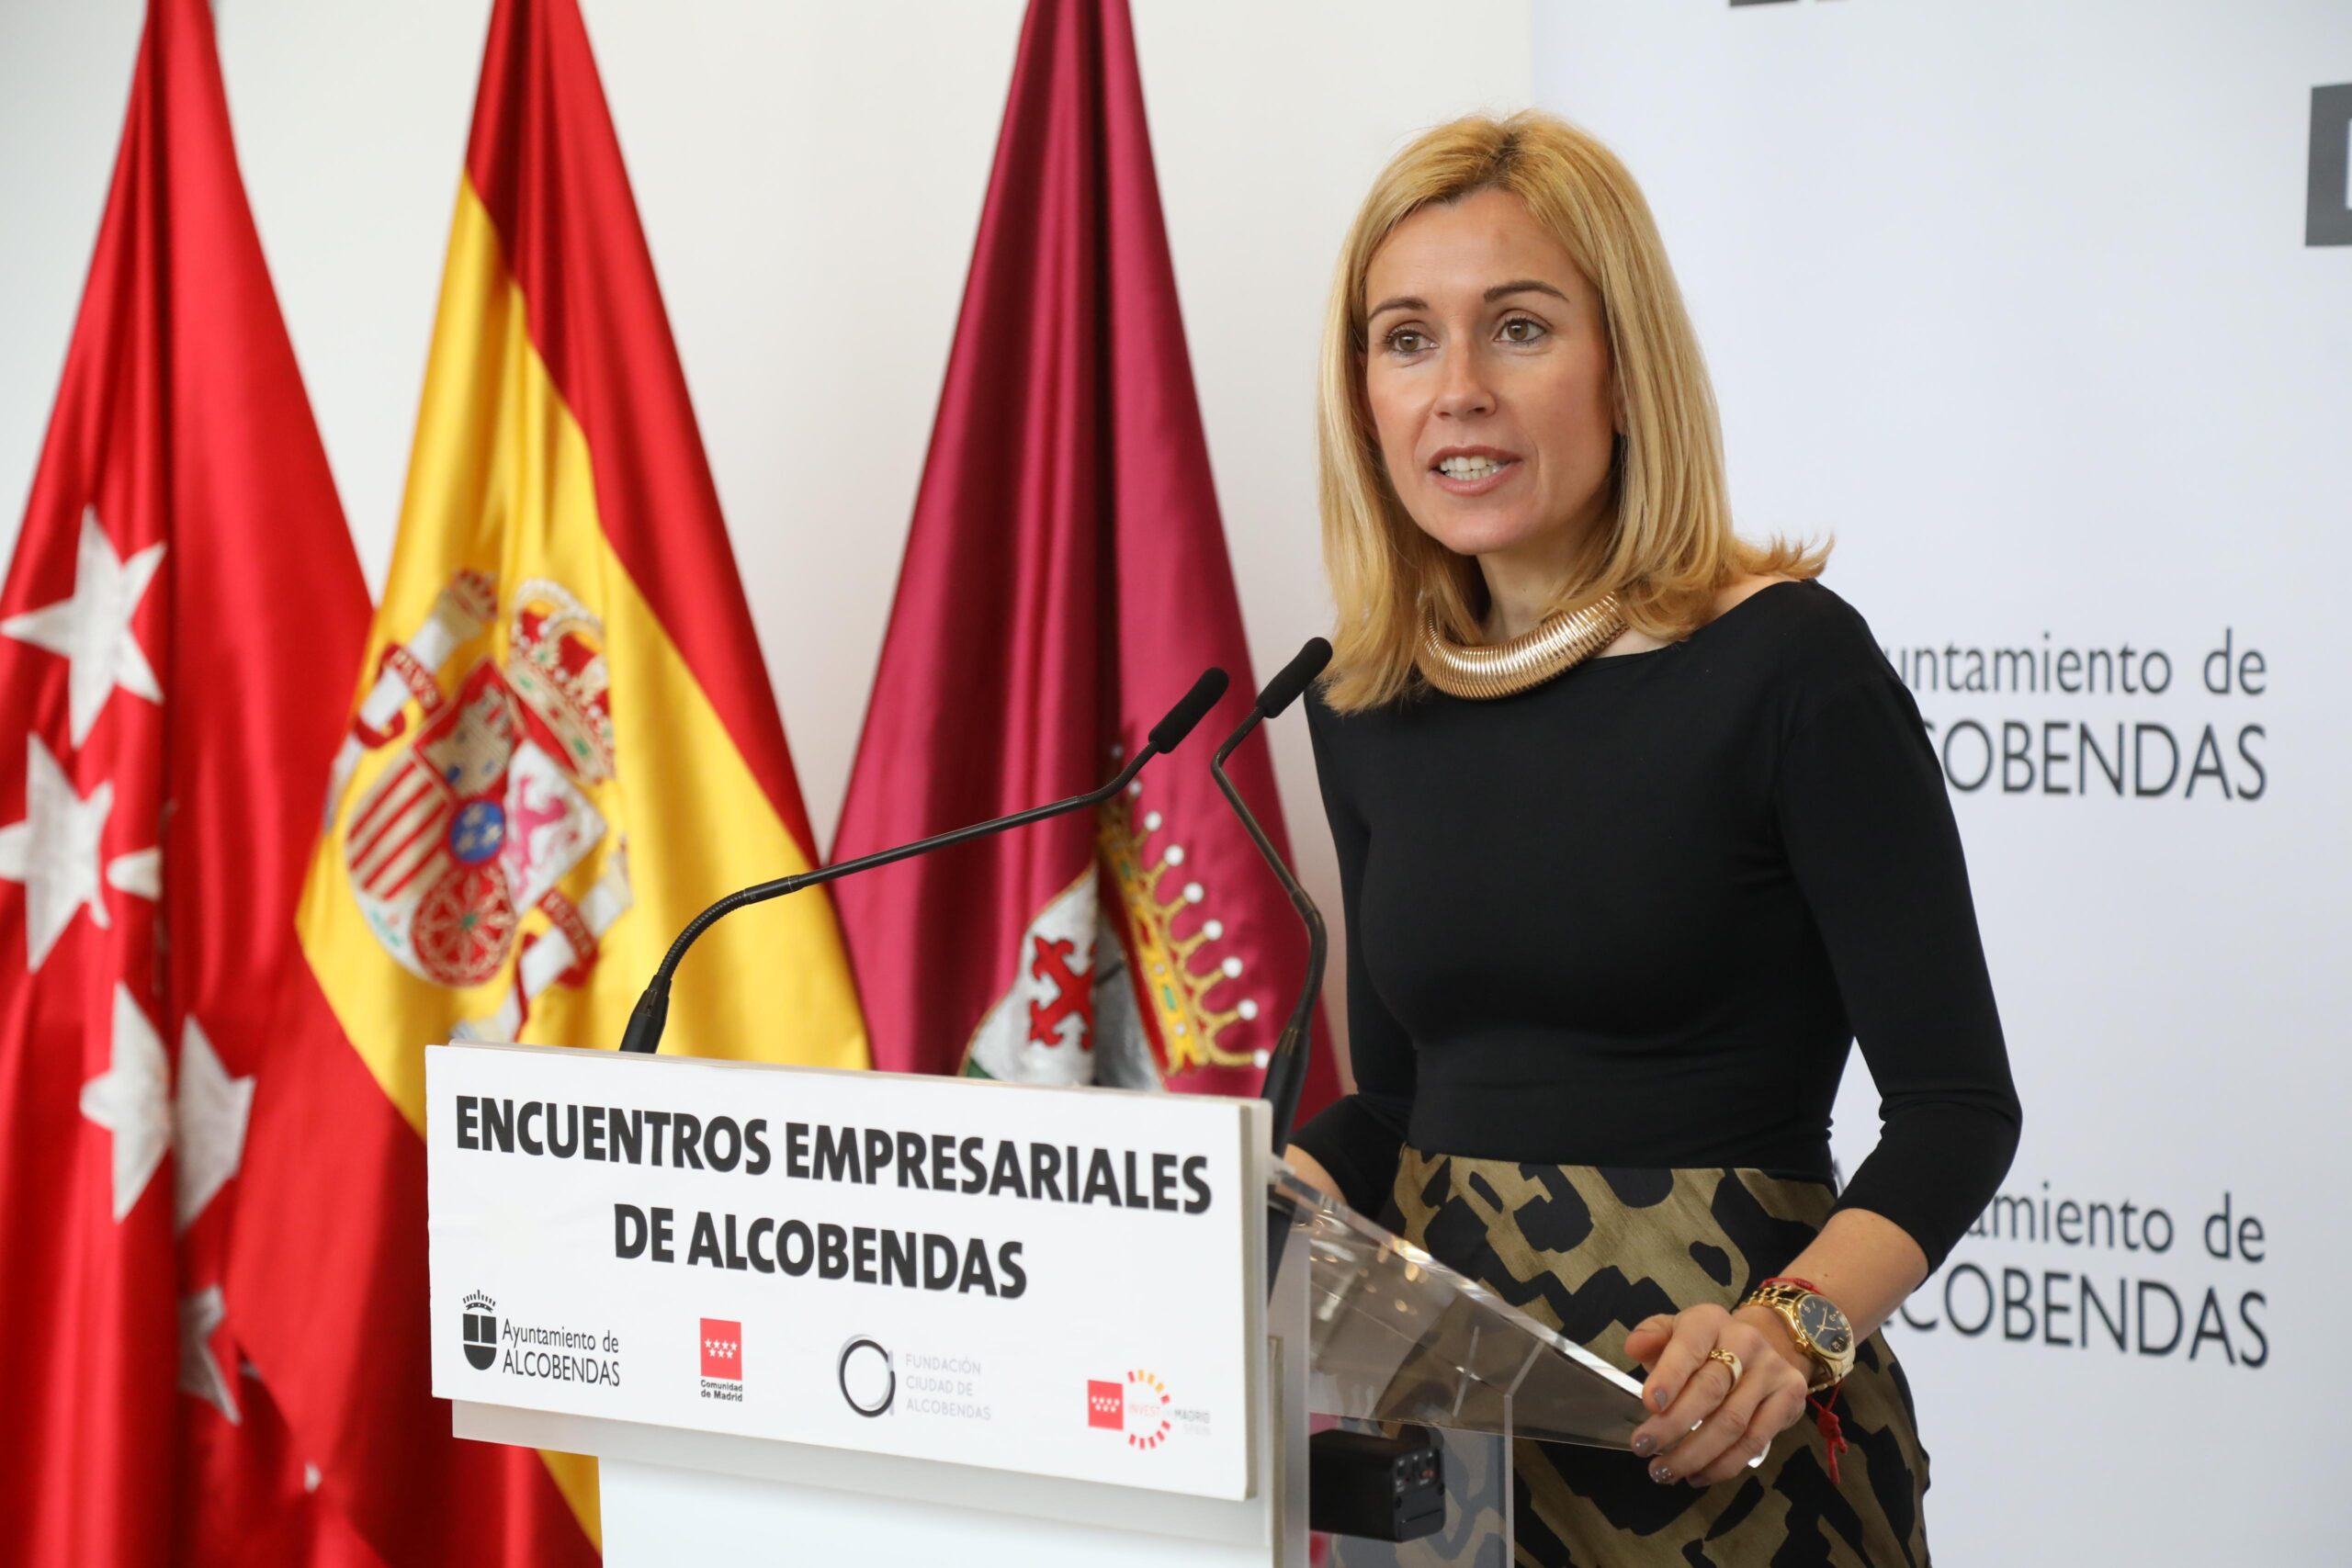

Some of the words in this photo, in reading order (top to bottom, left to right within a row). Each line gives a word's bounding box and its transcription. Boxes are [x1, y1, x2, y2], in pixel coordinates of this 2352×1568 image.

[2203, 628, 2266, 696] de
[1923, 718, 2267, 801] OBENDAS
[456, 1094, 772, 1177] ENCUENTROS
[786, 1122, 1212, 1215] EMPRESARIALES
[2203, 1191, 2266, 1264] de
[614, 1203, 675, 1263] DE
[687, 1211, 1027, 1300] ALCOBENDAS
[502, 1317, 597, 1351] Ayuntamiento
[602, 1329, 620, 1354] de
[502, 1348, 621, 1388] ALCOBENDAS
[905, 1353, 982, 1375] FUNDACIÓN
[700, 1379, 743, 1393] Comunidad
[700, 1388, 712, 1399] de
[713, 1390, 743, 1403] Madrid
[905, 1375, 955, 1394] CIUDAD
[957, 1381, 974, 1397] DE
[905, 1398, 992, 1421] ALCOBENDAS
